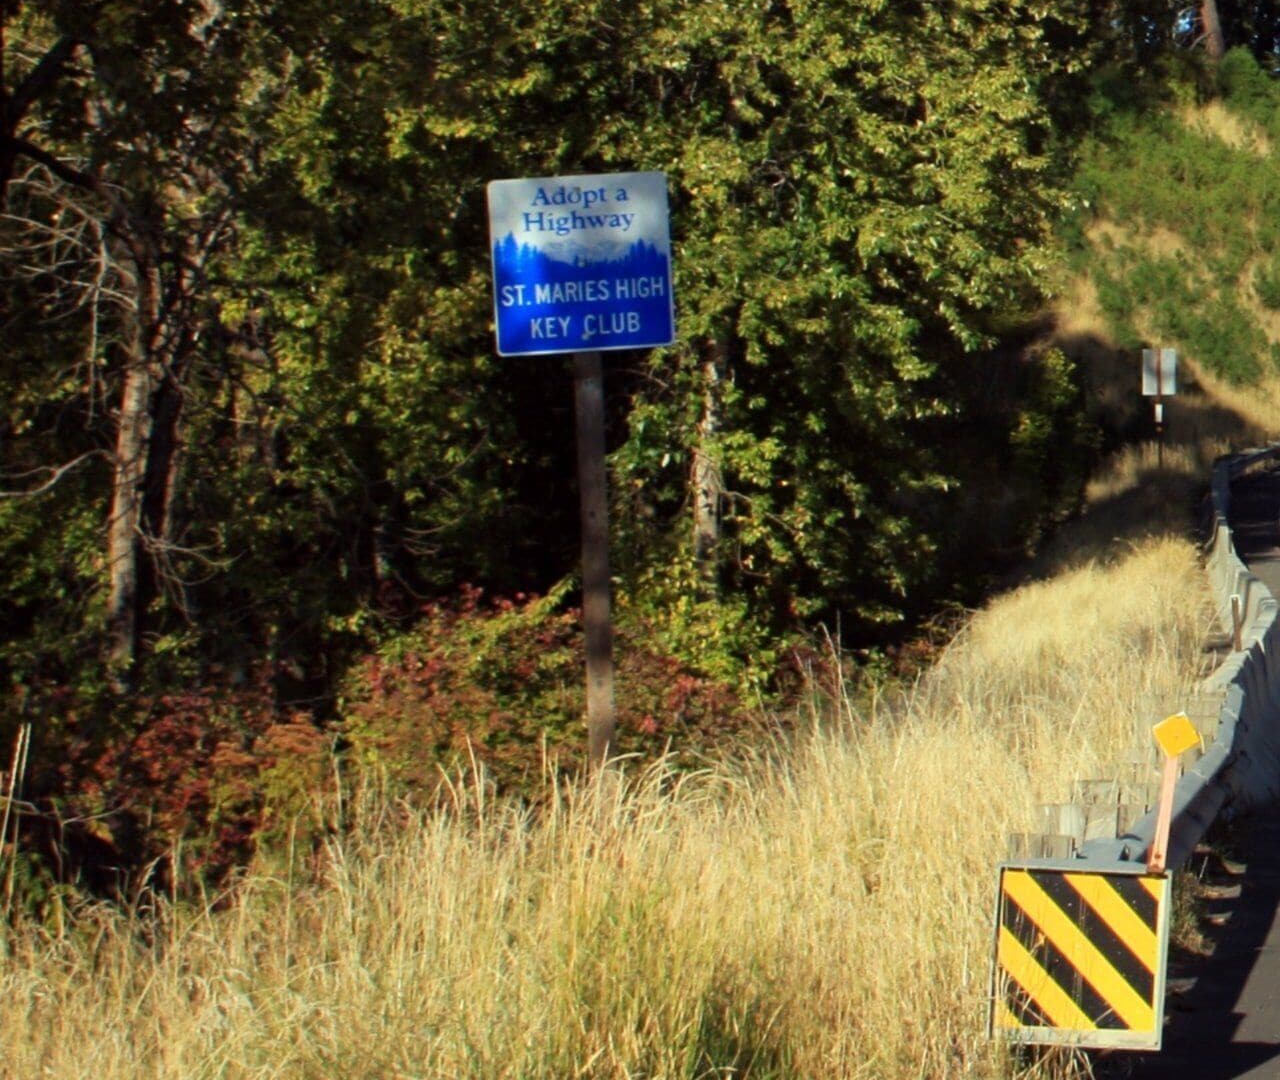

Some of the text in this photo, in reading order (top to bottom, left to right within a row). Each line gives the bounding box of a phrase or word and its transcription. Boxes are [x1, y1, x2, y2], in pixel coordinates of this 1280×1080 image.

[531, 186, 629, 208] Adopt a
[523, 210, 635, 235] Highway
[501, 276, 665, 307] ST. MARIES HIGH
[530, 311, 641, 339] KEY CLUB
